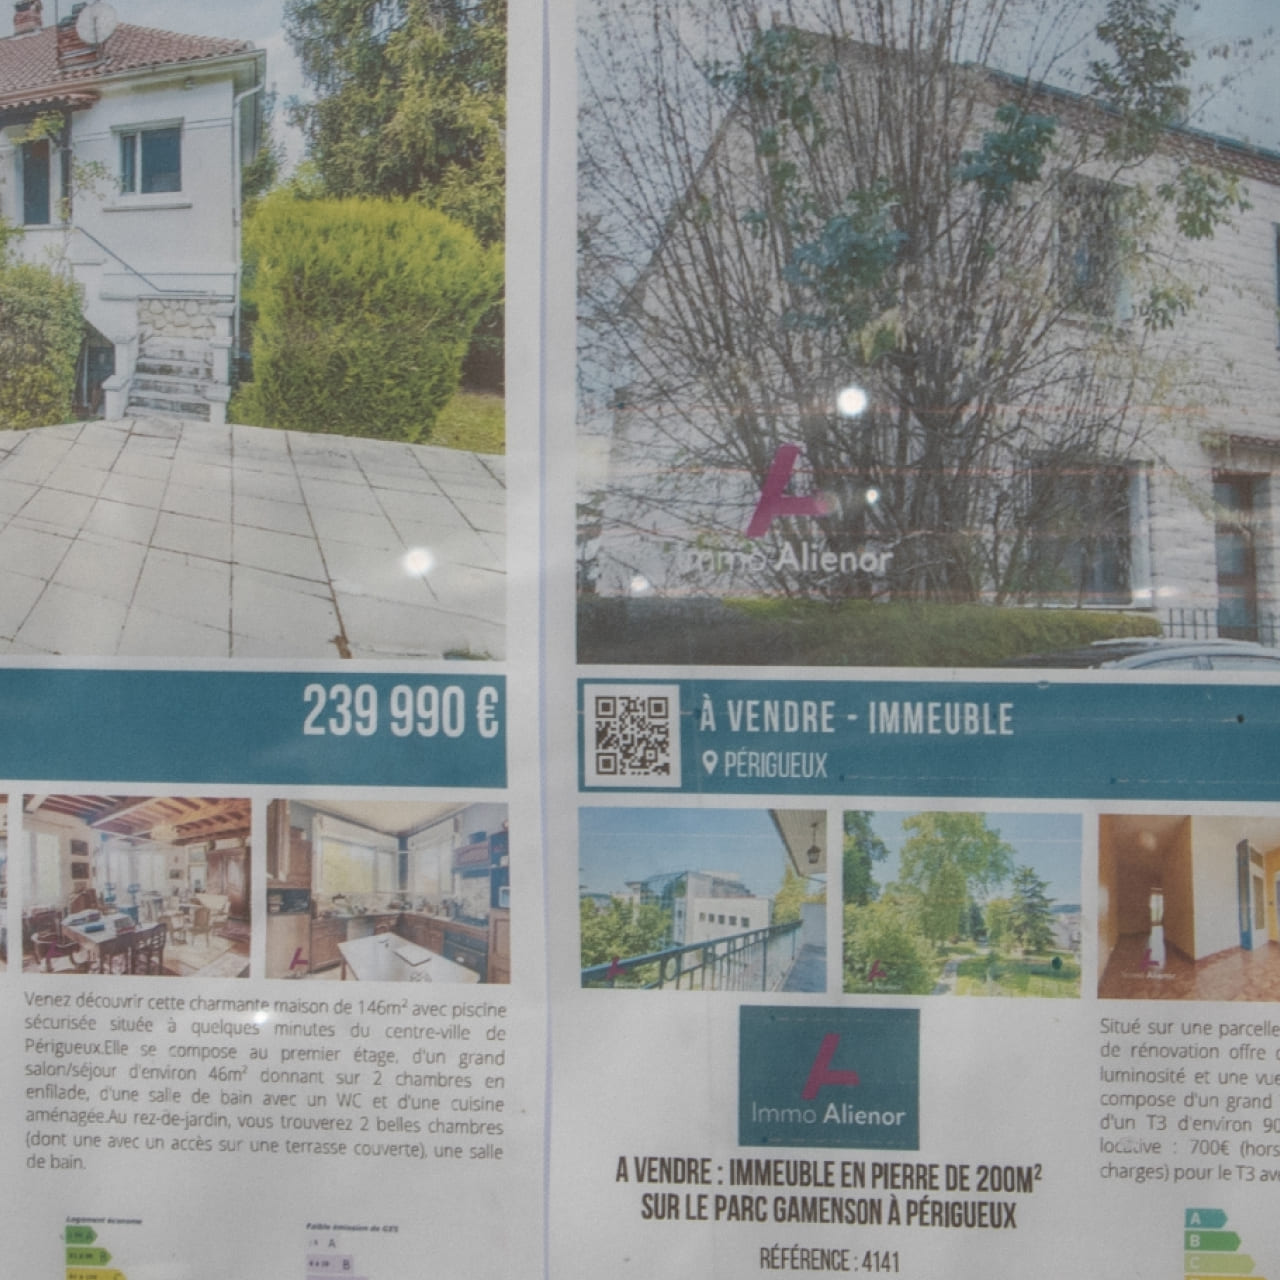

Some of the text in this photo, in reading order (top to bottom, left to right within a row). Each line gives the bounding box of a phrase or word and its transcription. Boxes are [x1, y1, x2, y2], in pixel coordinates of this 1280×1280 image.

[775, 542, 894, 573] Alienor
[303, 683, 499, 739] 239 990 €
[699, 692, 717, 732] À
[726, 699, 836, 733] VENDRE
[869, 700, 1014, 736] IMMEUBLE
[724, 746, 828, 779] PÉRIGUEUX
[1099, 1040, 1122, 1058] de
[1130, 1041, 1220, 1060] rénovation
[1228, 1042, 1267, 1061] offre
[24, 1060, 118, 1086] salon/séjour
[127, 1062, 198, 1081] d'environ
[259, 1067, 325, 1085] donnant
[335, 1072, 361, 1086] sur
[372, 1069, 383, 1087] 2
[394, 1067, 473, 1089] chambres
[484, 1075, 506, 1089] en
[752, 1101, 907, 1127] Immo Alienor
[615, 1155, 629, 1183] A
[633, 1155, 713, 1186] VENDRE
[729, 1158, 836, 1188] IMMEUBLE
[840, 1160, 866, 1189] EN
[871, 1161, 940, 1191] PIERRE
[944, 1163, 971, 1192] DE
[640, 1192, 1017, 1230] SUR LE PARC GAMENSON À PÉRIGUEUX
[759, 1242, 851, 1272] RÉFÉRENCE
[861, 1249, 900, 1273] 4141
